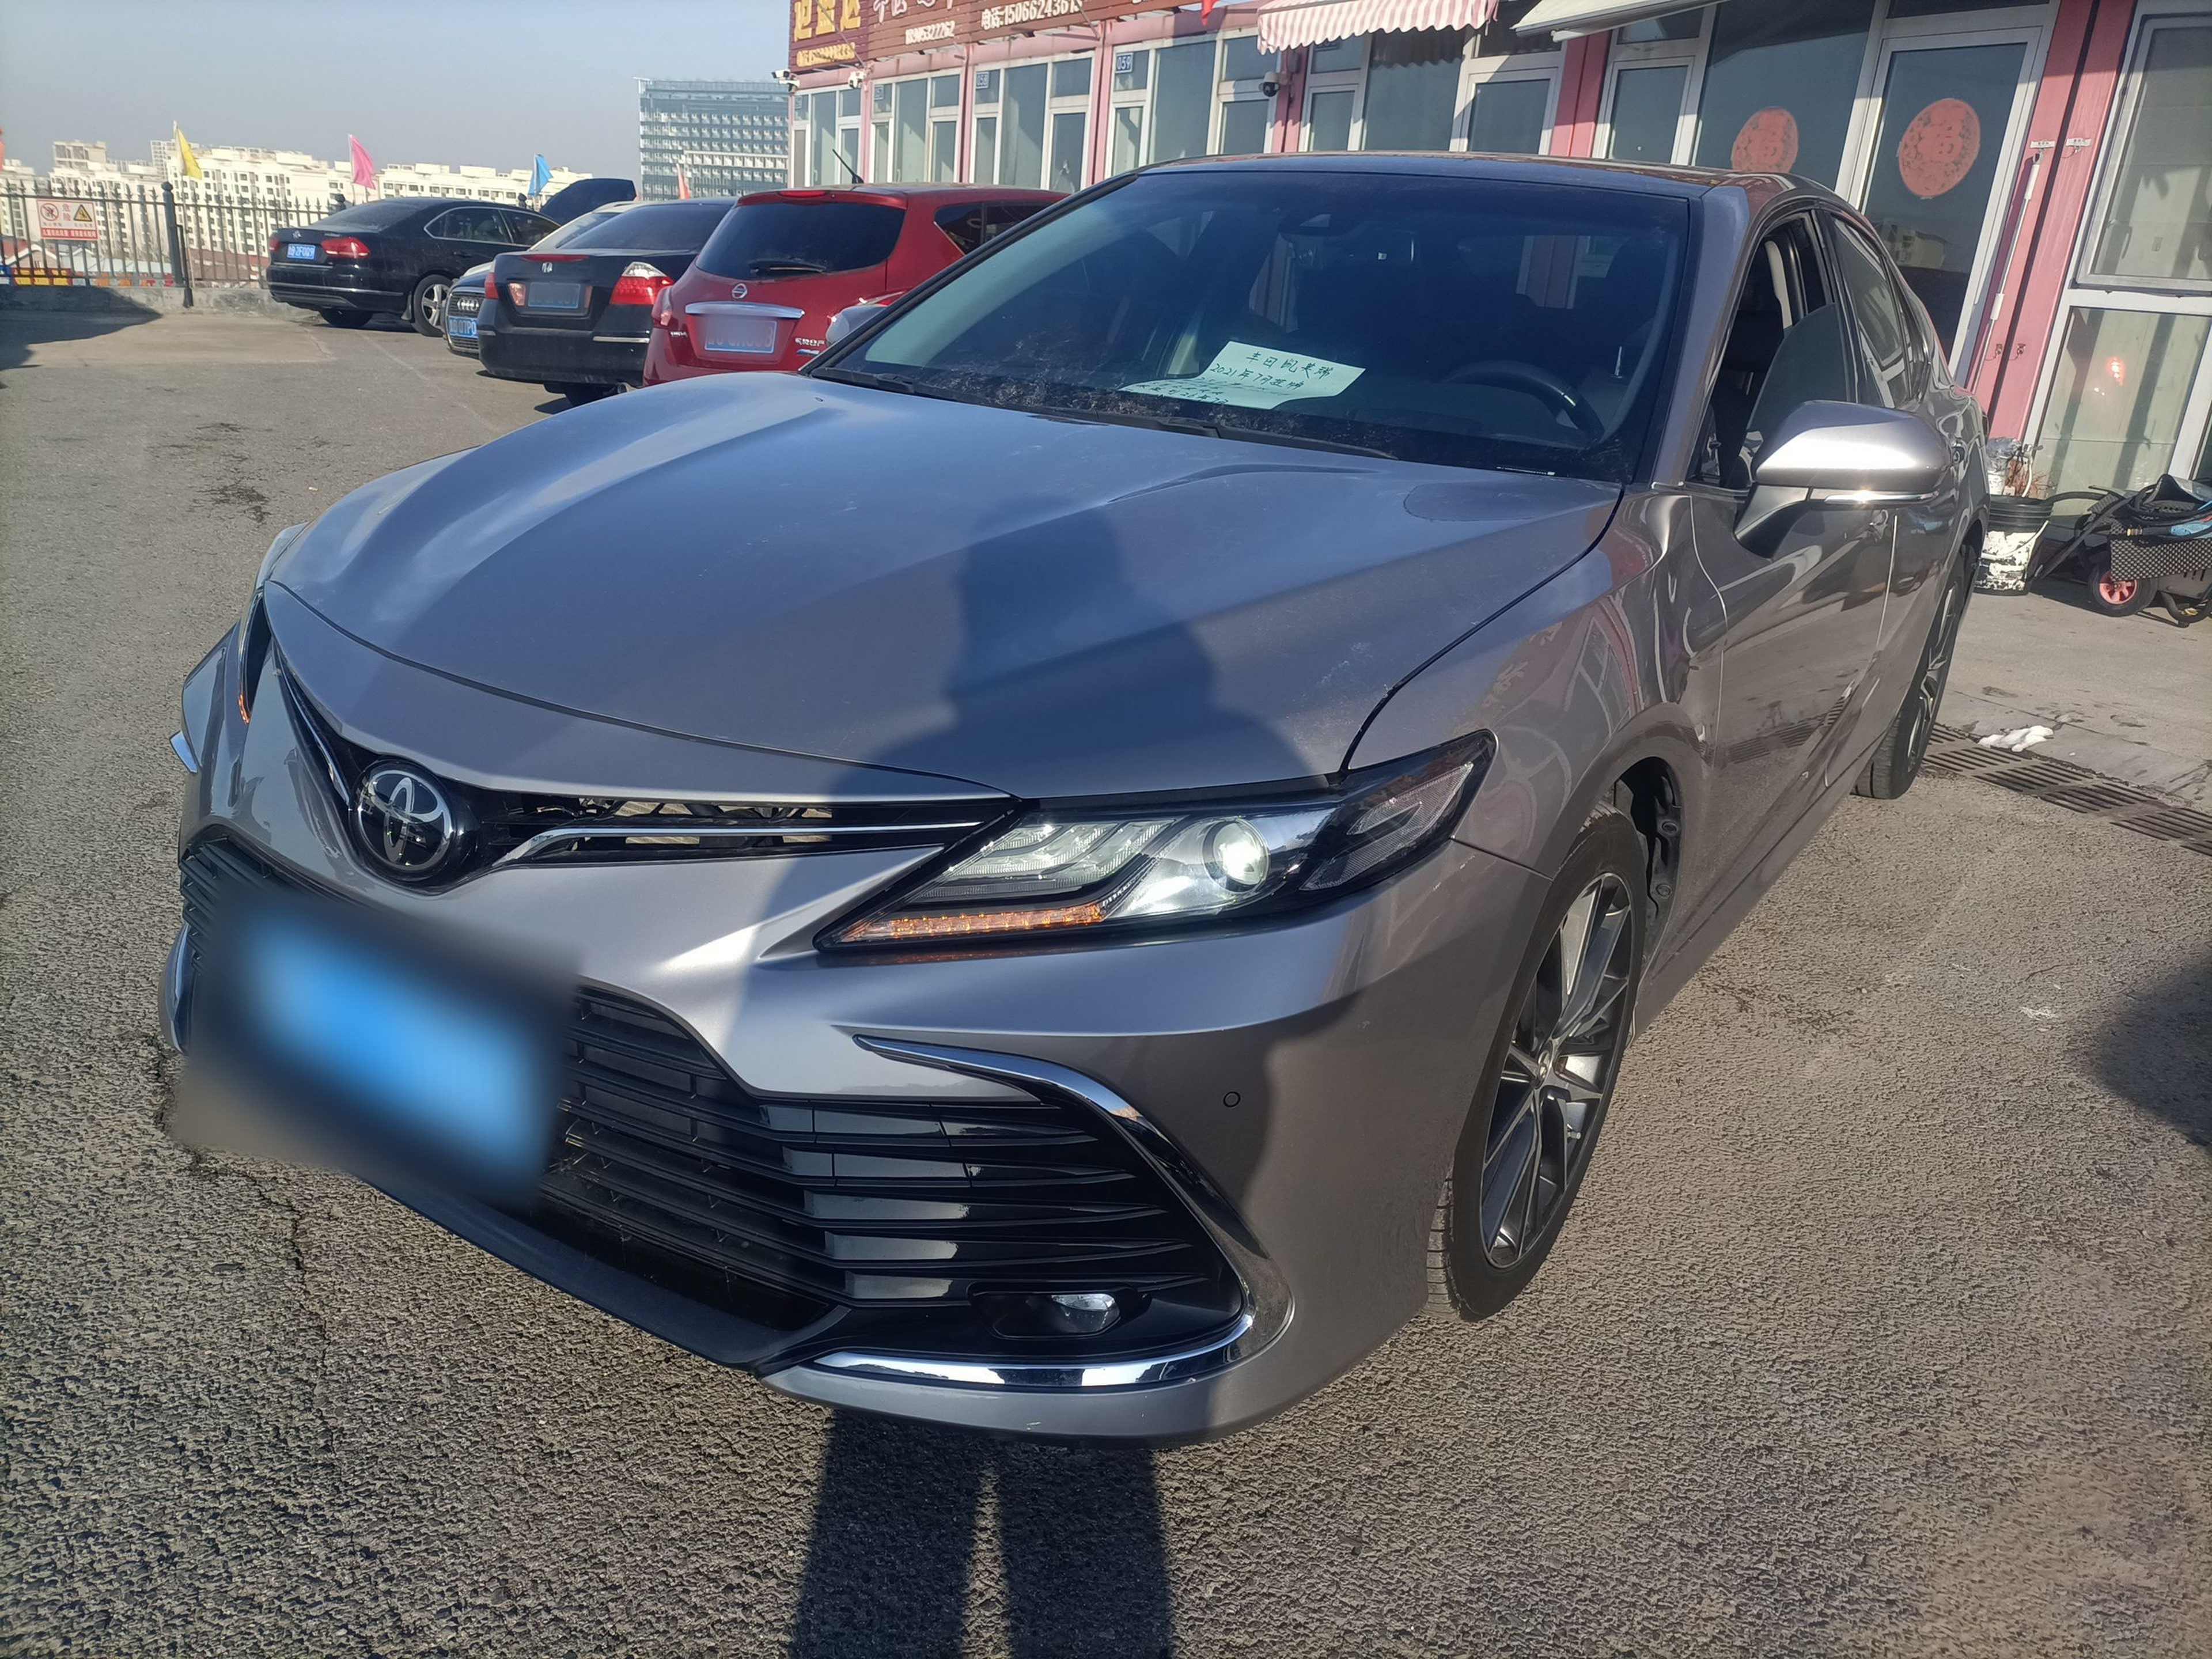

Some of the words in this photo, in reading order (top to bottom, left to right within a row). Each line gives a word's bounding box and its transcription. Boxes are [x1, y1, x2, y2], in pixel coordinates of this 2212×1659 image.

[1117, 56, 1132, 70] 059
[1210, 363, 1305, 391] 2021年7月挂牌
[1246, 351, 1334, 380] 丰田凯美瑞
